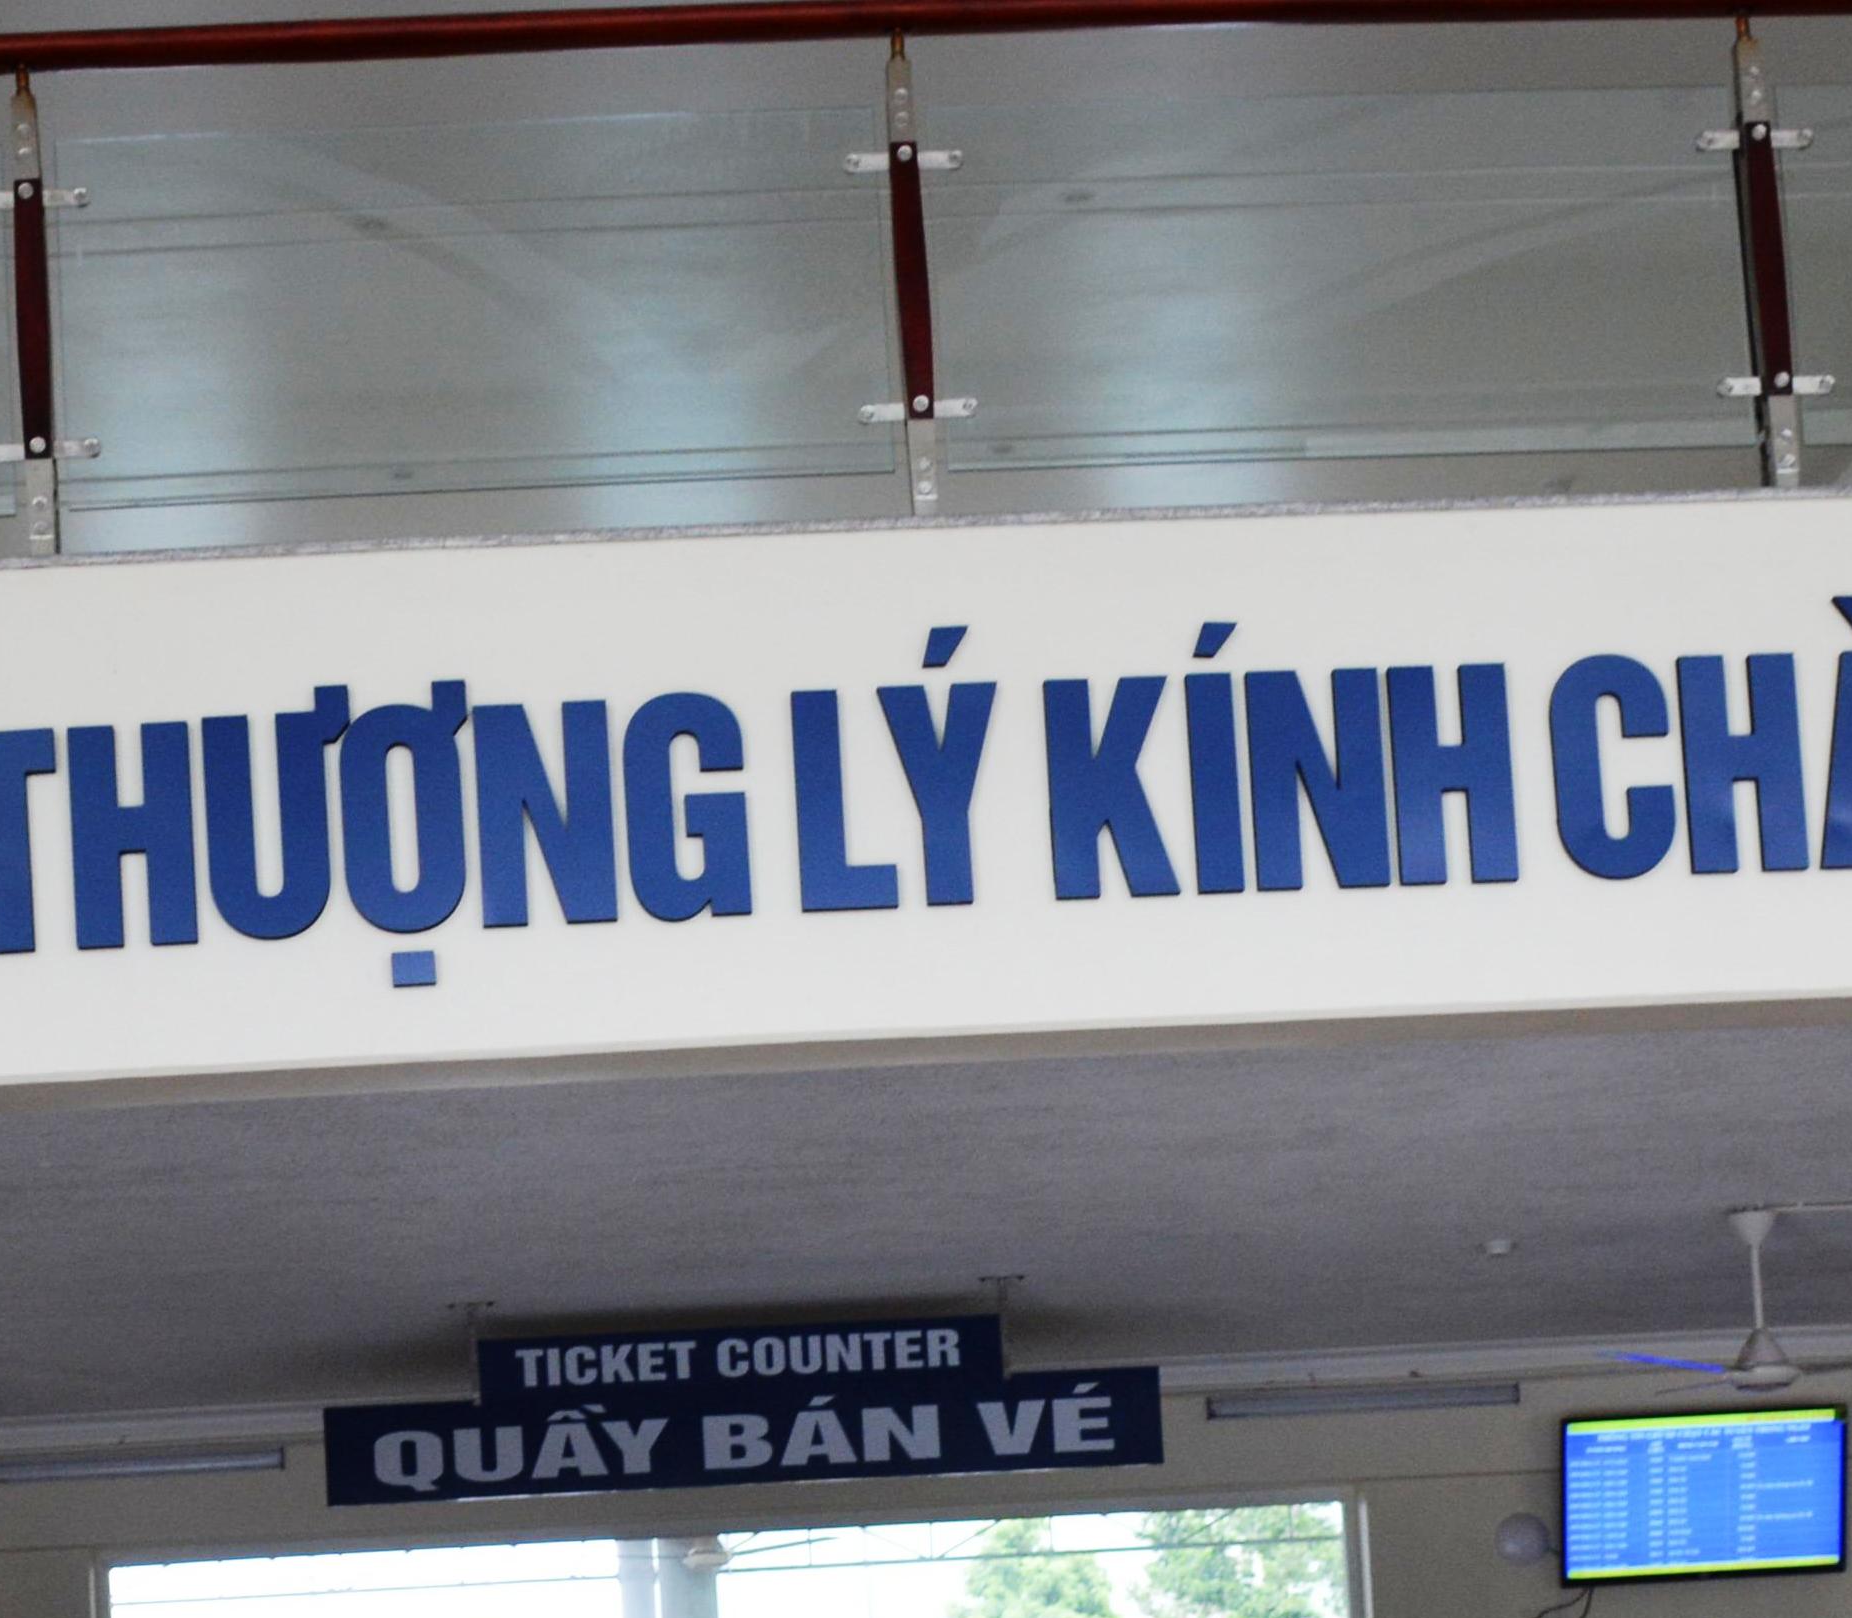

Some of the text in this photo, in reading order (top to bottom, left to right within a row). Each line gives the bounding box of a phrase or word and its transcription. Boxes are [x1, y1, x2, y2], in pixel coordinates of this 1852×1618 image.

[791, 626, 996, 911] LÝ
[1045, 623, 1518, 900] KÍNH
[516, 1328, 960, 1387] TICKET COUNTER
[373, 1382, 1115, 1491] QUẦY BÁN VÉ
